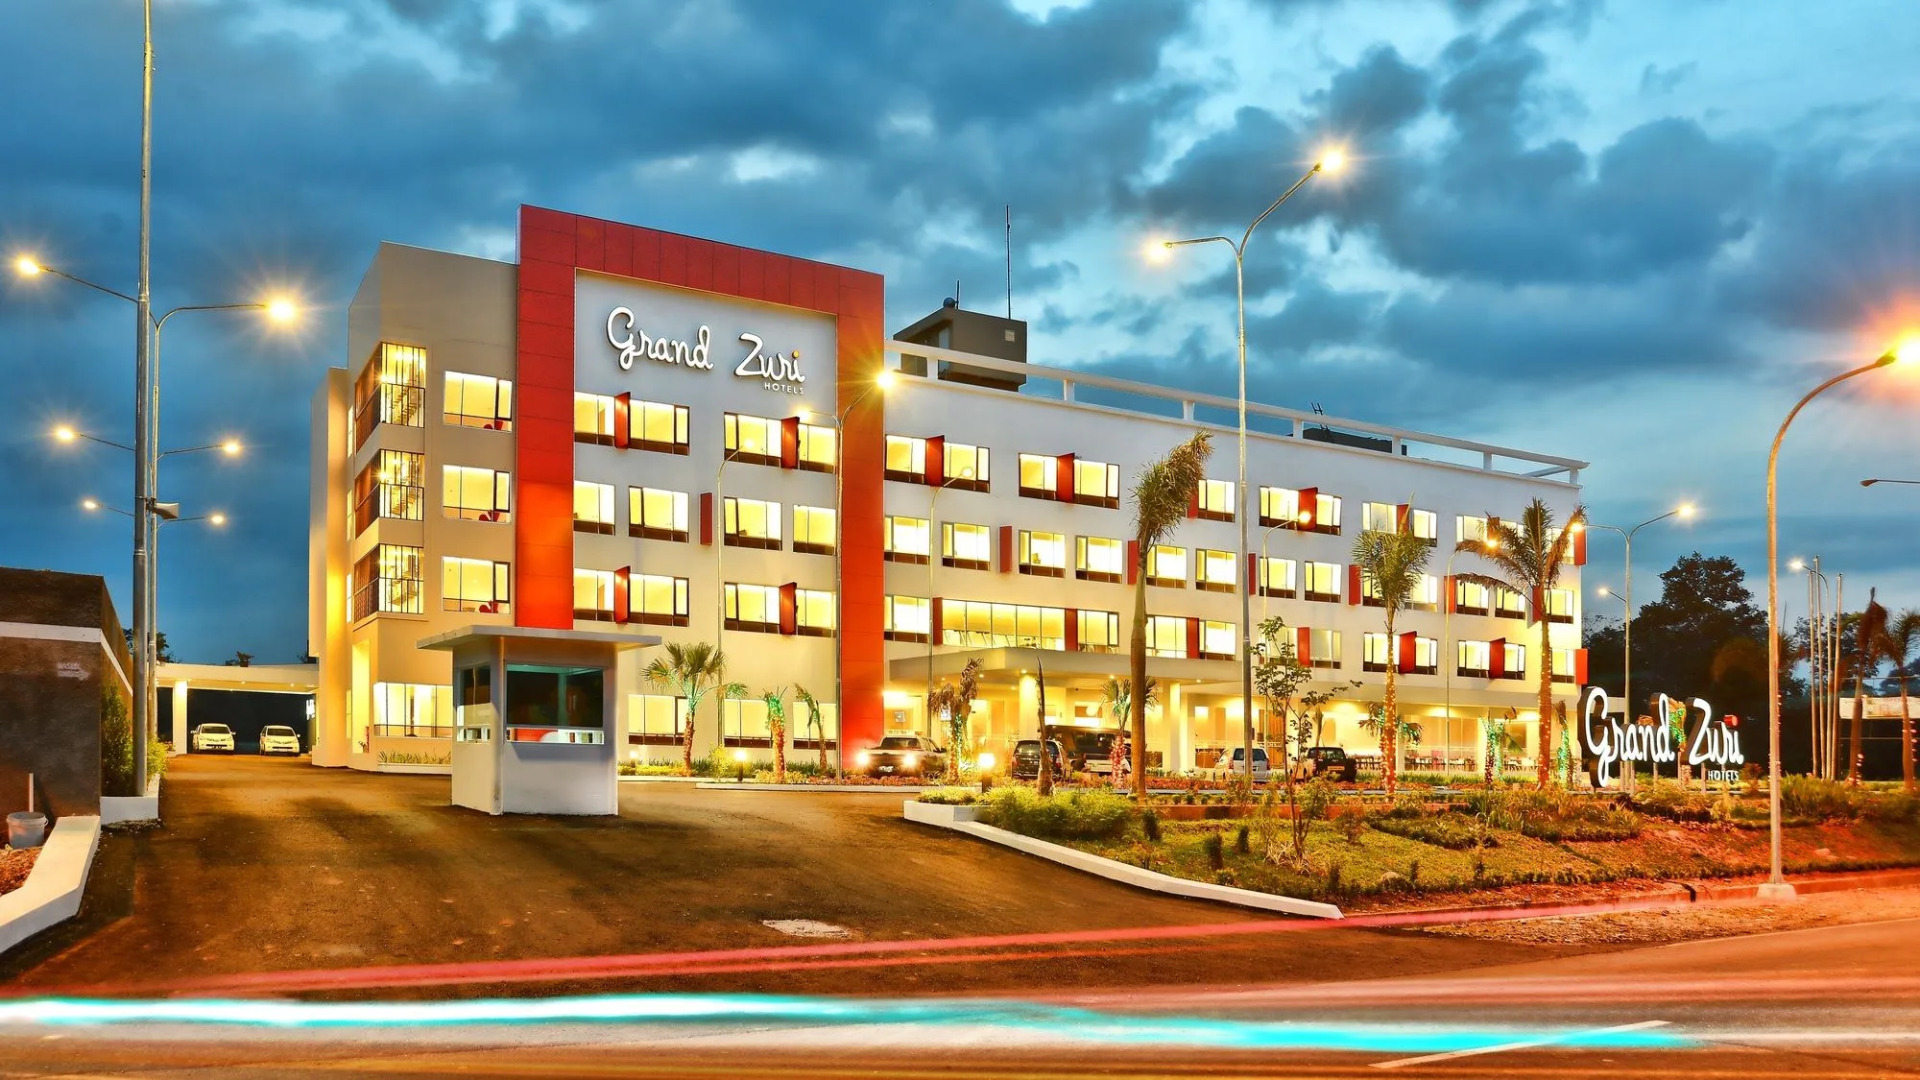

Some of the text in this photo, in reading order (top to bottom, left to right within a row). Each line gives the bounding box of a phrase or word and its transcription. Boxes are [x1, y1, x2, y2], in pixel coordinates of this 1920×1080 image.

[607, 306, 806, 382] Grand Zuri
[764, 382, 805, 395] HOTELS
[1585, 686, 1745, 788] Grand Zuri
[1707, 769, 1740, 782] HOTELS
